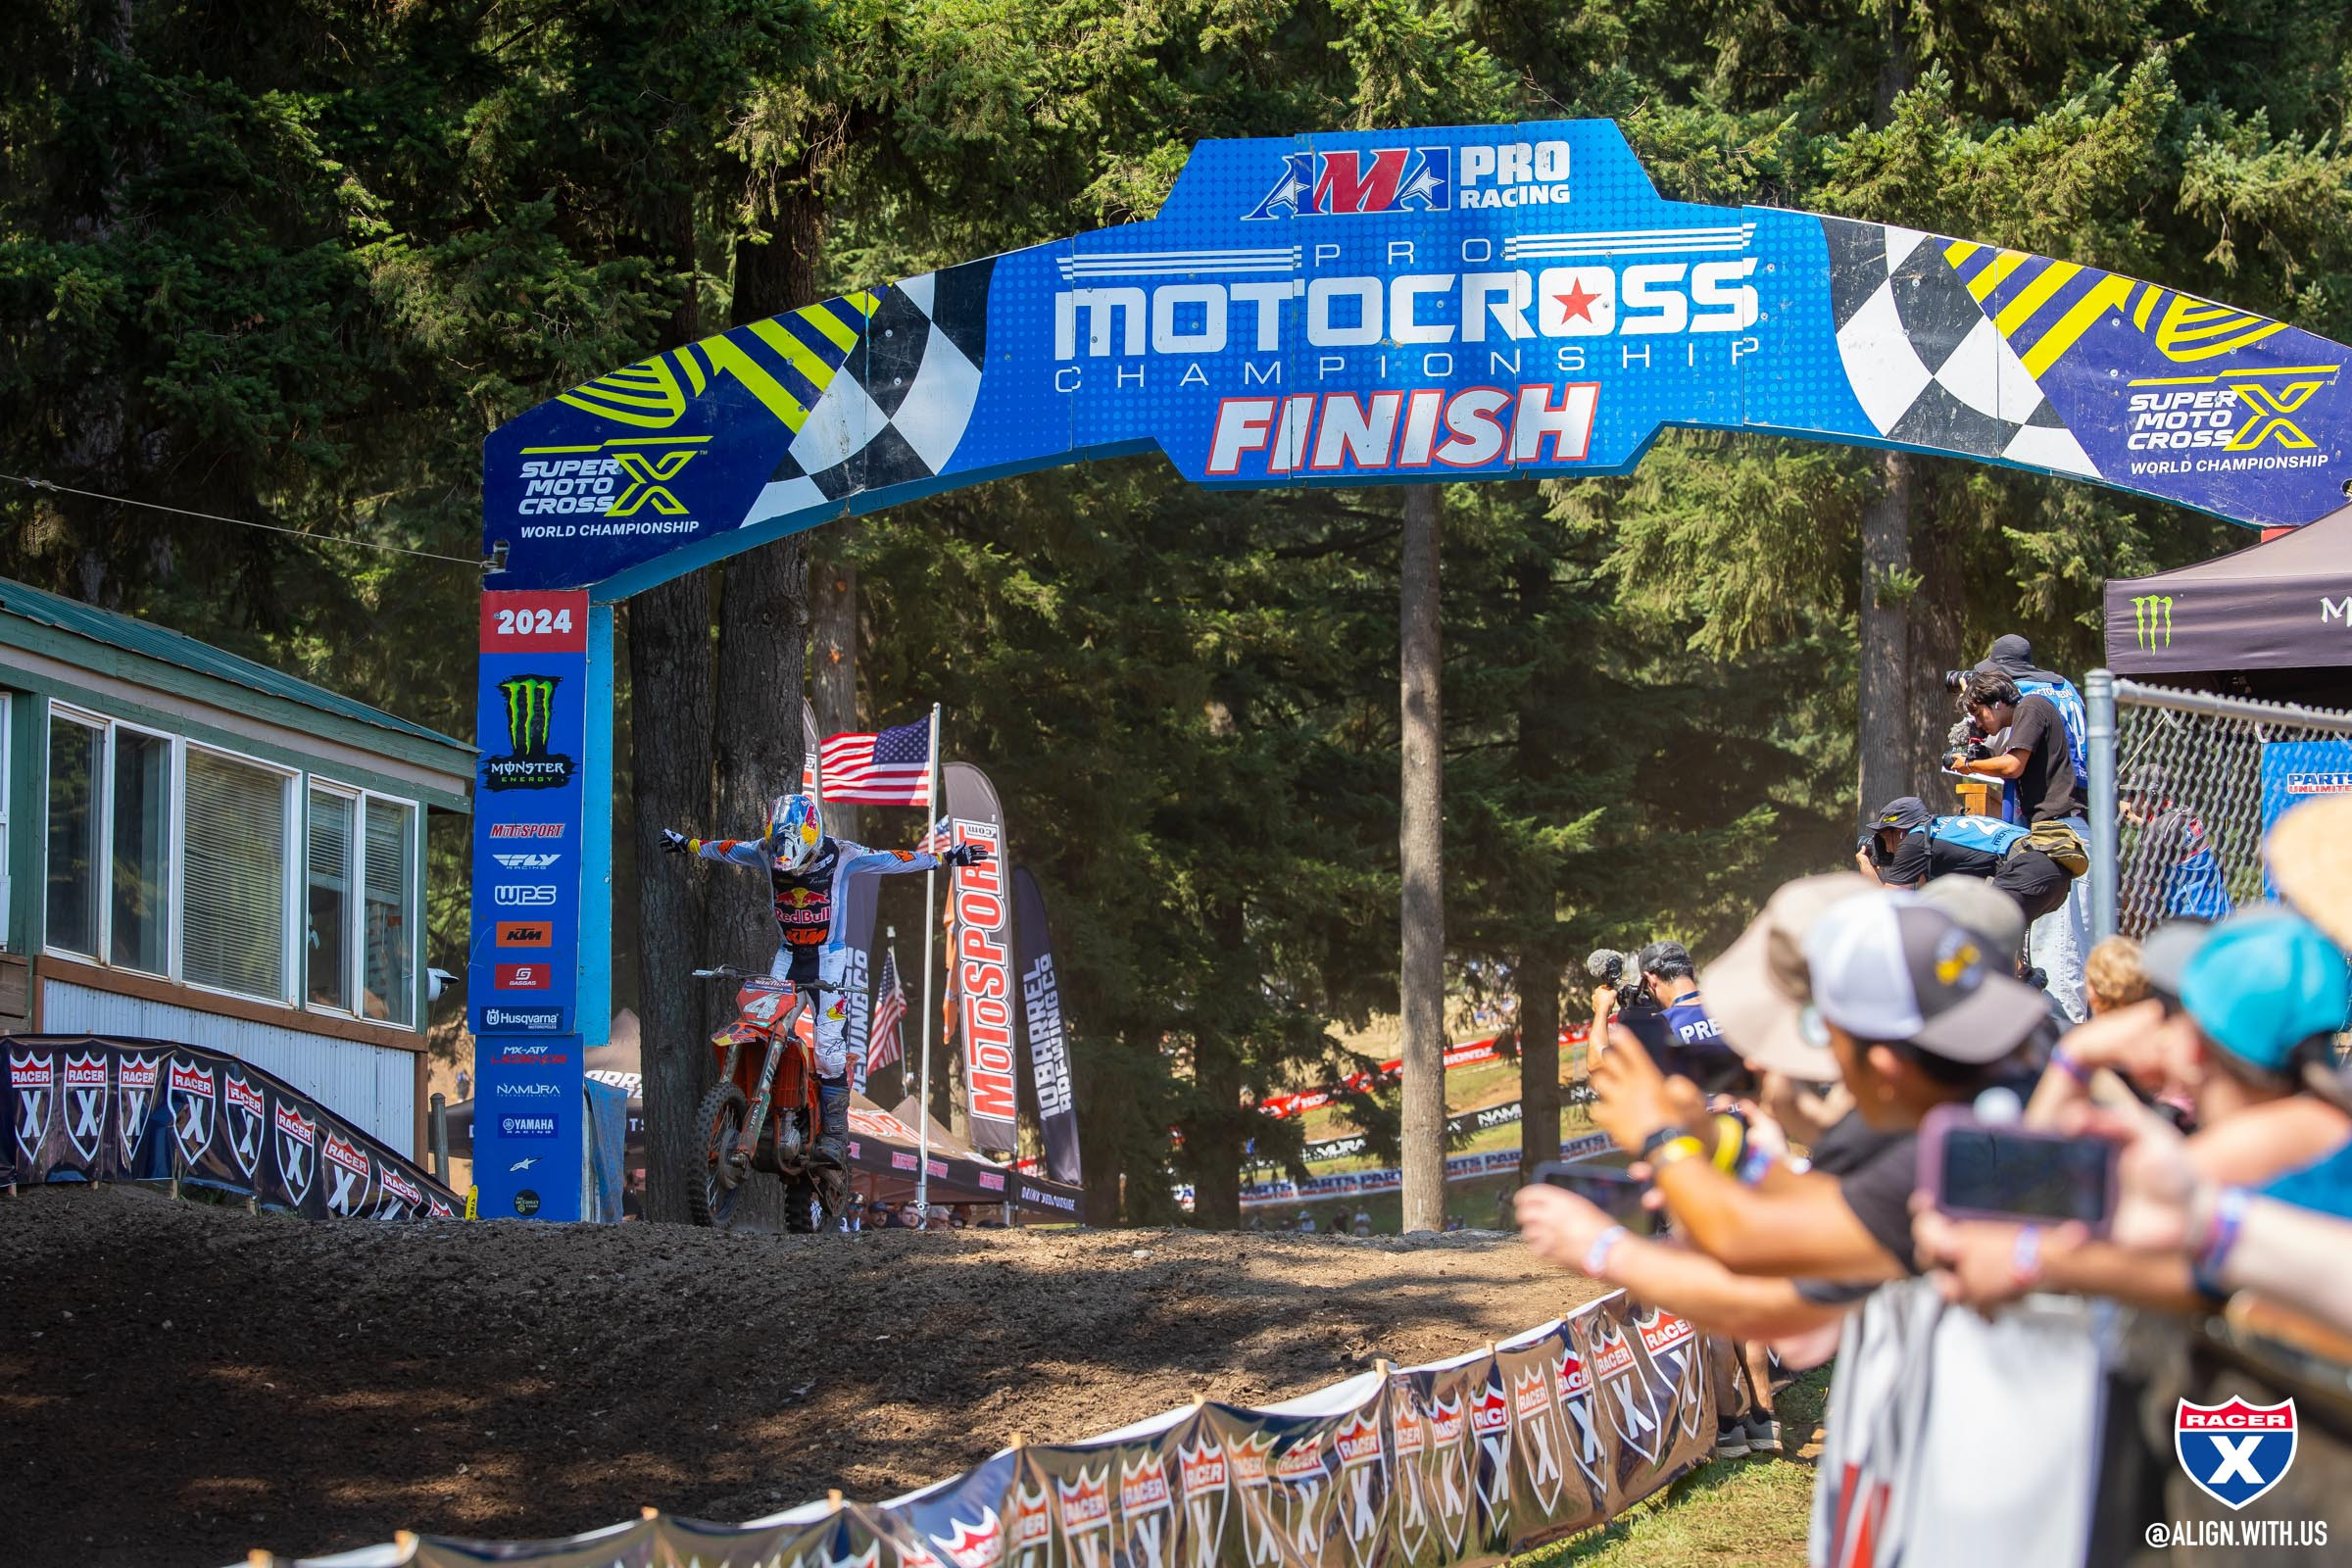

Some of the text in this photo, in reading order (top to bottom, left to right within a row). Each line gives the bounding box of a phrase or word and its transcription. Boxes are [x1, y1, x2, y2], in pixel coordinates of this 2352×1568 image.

[1460, 140, 1570, 185] PRO
[1240, 147, 1450, 221] AMA
[1459, 184, 1570, 209] RACING
[1316, 238, 1492, 268] PRO
[1055, 257, 1758, 361] MOTOCROSS
[1055, 337, 1759, 392] CHAMPIONSHIP
[2128, 390, 2237, 412] SUPER
[1205, 381, 1600, 475] FINISH
[2134, 410, 2233, 431] MOTO
[2128, 429, 2234, 450] CROSS
[519, 459, 620, 478] SUPER
[2131, 455, 2328, 474] WORLD CHAMPIONSHIP
[525, 477, 613, 496] MOTO
[518, 496, 615, 514] CROSS
[521, 521, 699, 538] WORLD CHAMPIONSHIP
[497, 610, 572, 635] 2024
[491, 760, 565, 775] MONSTER
[2288, 785, 2352, 794] UNLIMITE
[491, 823, 565, 838] MOTOSPORT
[495, 855, 562, 866] FLY
[495, 886, 557, 905] WPS
[775, 906, 830, 923] Red Bull
[507, 928, 542, 940] KTM
[785, 928, 828, 946] KTM
[743, 992, 782, 1019] 4
[501, 1012, 558, 1025] Husqvarna
[12, 1071, 49, 1082] RACER
[69, 1070, 104, 1082] RACER
[122, 1071, 154, 1083] RACER
[175, 1075, 211, 1093] RACER
[496, 1083, 561, 1094] NAMURA
[22, 1091, 41, 1138] X
[76, 1091, 98, 1136] X
[126, 1091, 145, 1136] X
[181, 1095, 205, 1143] X
[514, 1118, 554, 1130] YAMAHA
[239, 1108, 255, 1159] X
[279, 1115, 311, 1141] RACER
[286, 1136, 305, 1187] X
[328, 1144, 368, 1173] RACER
[327, 1165, 356, 1215] X
[385, 1174, 419, 1201] RACER
[1597, 1348, 1631, 1373] RACER
[1669, 1344, 1696, 1411] X
[1519, 1387, 1546, 1411] RACER
[1611, 1374, 1655, 1440] X
[1568, 1396, 1604, 1463] X
[1340, 1436, 1378, 1458] RACER
[1531, 1416, 1559, 1485] X
[1482, 1435, 1509, 1504] X
[1125, 1478, 1166, 1503] RACER
[1443, 1449, 1463, 1517] X
[1065, 1494, 1105, 1523] RACER
[1351, 1466, 1376, 1542] X
[1295, 1480, 1319, 1554] X
